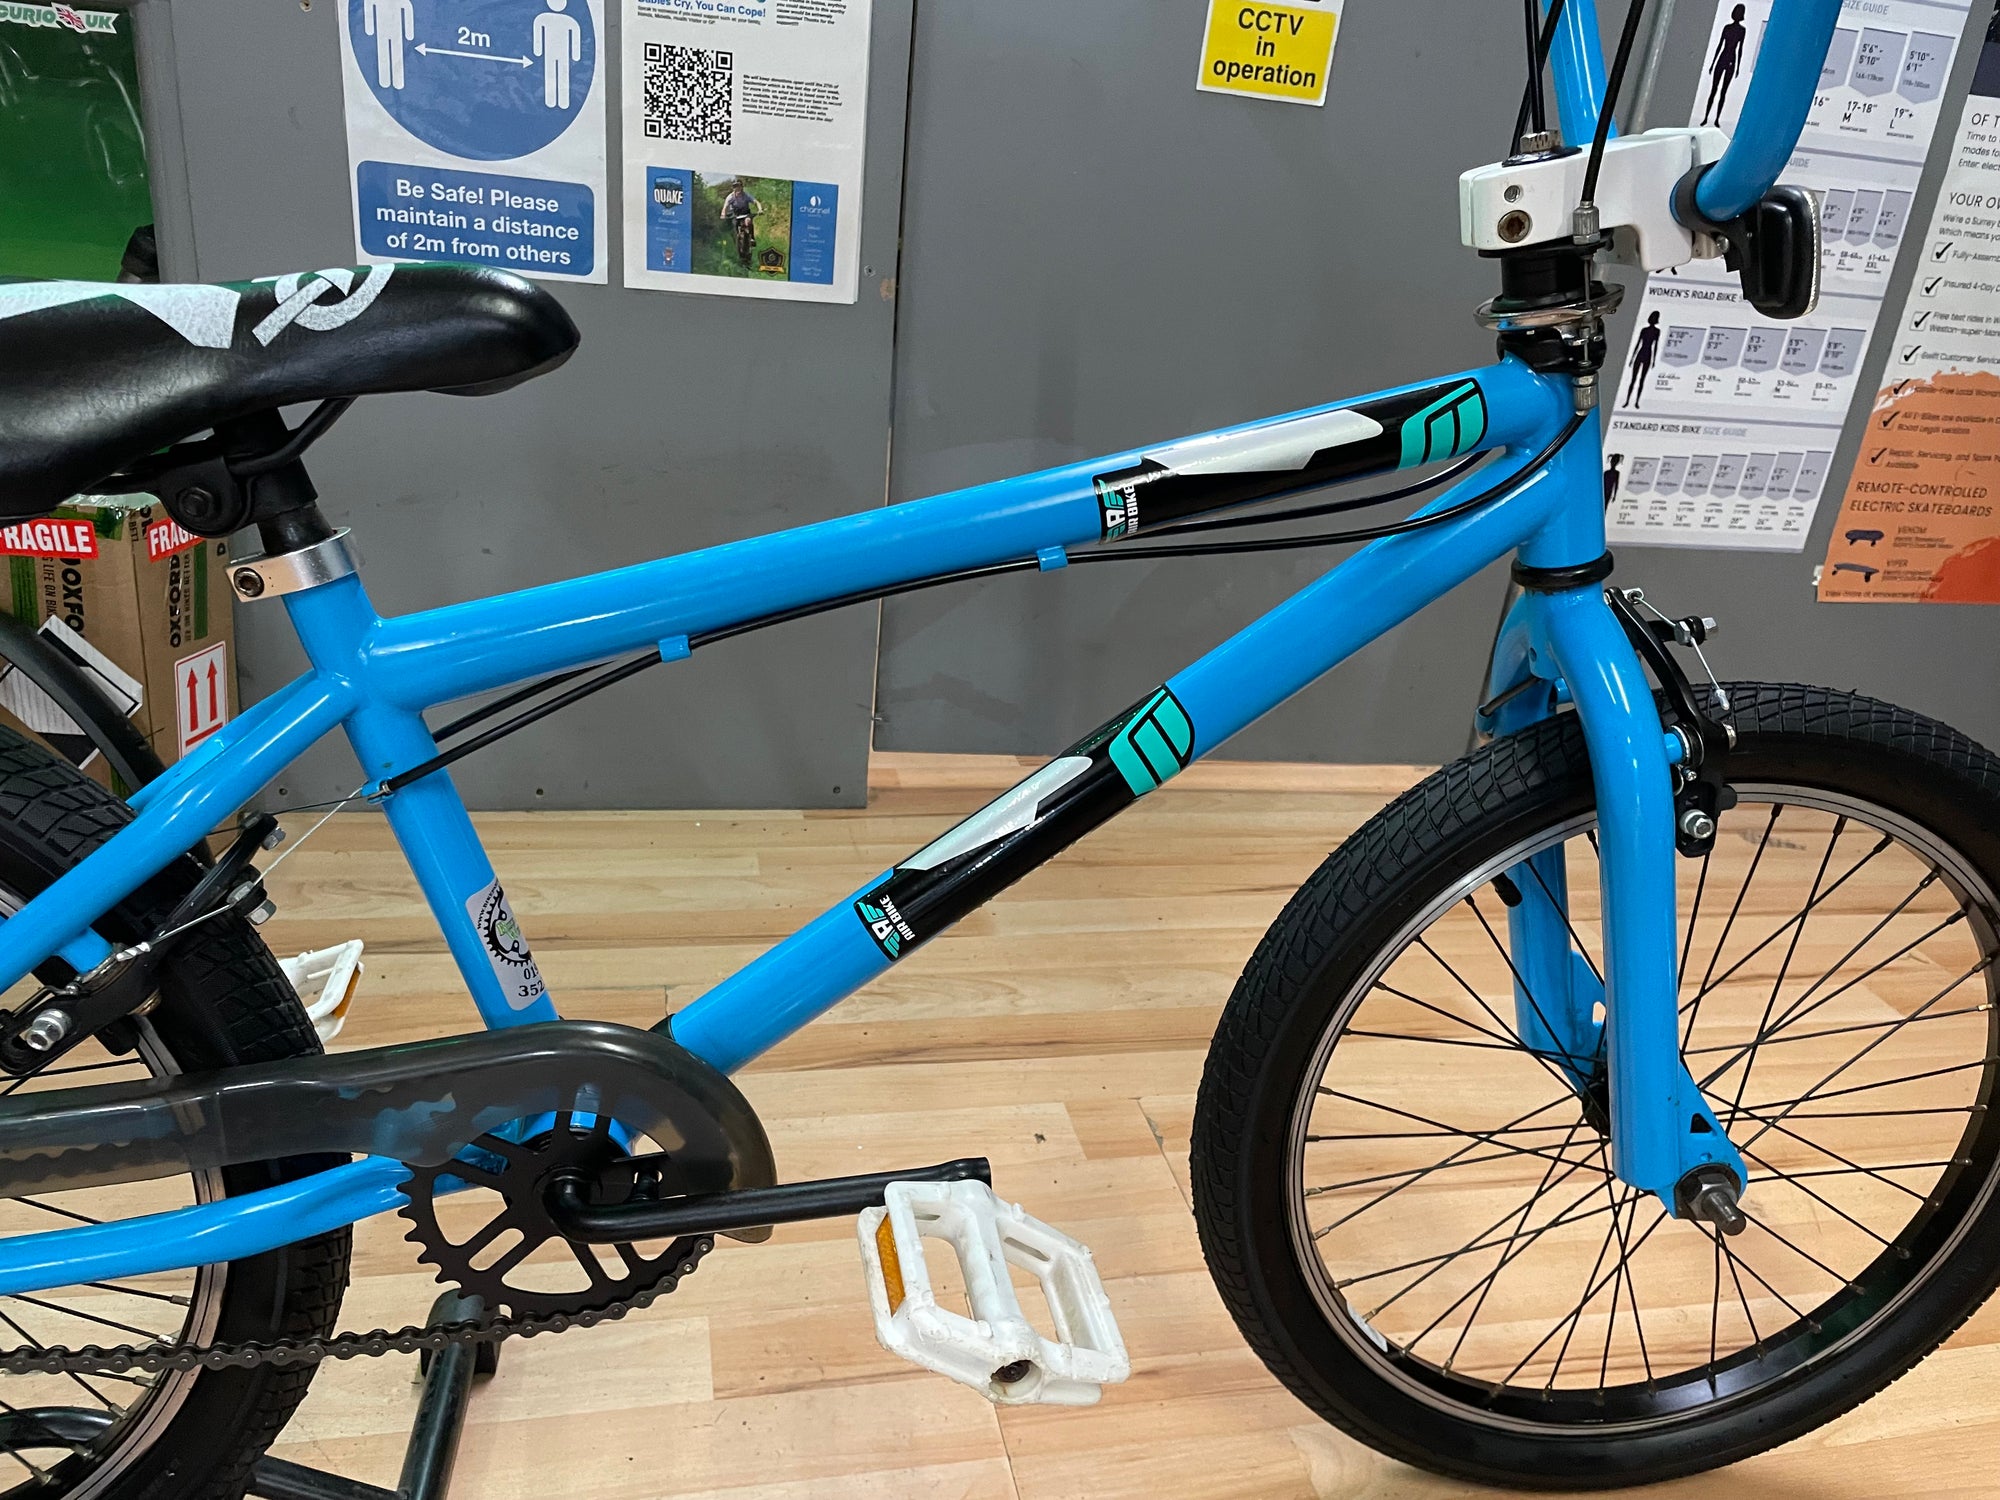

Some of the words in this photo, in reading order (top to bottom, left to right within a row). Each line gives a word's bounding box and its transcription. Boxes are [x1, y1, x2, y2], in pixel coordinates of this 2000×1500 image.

[695, 1, 714, 11] You
[716, 3, 735, 14] Can
[738, 6, 766, 18] Cope!
[1863, 2, 1889, 15] GUIDE
[86, 14, 113, 30] UK
[1238, 8, 1304, 35] CCTV
[457, 26, 491, 47] 2m
[1256, 36, 1275, 57] in
[1213, 60, 1316, 88] operation
[1842, 113, 1852, 123] M
[1889, 119, 1895, 129] L
[1971, 113, 1990, 126] OF
[1967, 131, 1986, 142] Time
[1988, 134, 1997, 143] to
[1962, 146, 1990, 156] modes
[1958, 158, 1980, 169] Enter
[396, 179, 425, 198] Be
[431, 183, 484, 204] Safe!
[490, 189, 559, 212] Please
[654, 188, 684, 205] QUAKE
[1949, 192, 1983, 207] YOUR
[376, 206, 467, 229] maintain
[473, 218, 486, 231] a
[492, 217, 579, 241] distance
[386, 233, 408, 248] of
[413, 234, 445, 252] 2m
[451, 238, 500, 258] from
[506, 246, 571, 265] others
[1649, 287, 1690, 299] WOMEN'S
[1691, 290, 1715, 301] ROAD
[1716, 292, 1738, 303] BIKE
[1612, 421, 1659, 432] STANDARD
[1660, 423, 1680, 433] KIDS
[1681, 425, 1702, 435] BIKE
[1856, 481, 1988, 499] REMOTE-CONTROLLED
[1123, 484, 1139, 517] BIKE
[1850, 499, 1905, 513] ELECTRIC
[1907, 501, 1993, 517] SKATEBOARDS
[169, 554, 181, 648] OXFORD
[879, 894, 902, 924] BIKE
[896, 921, 916, 941] AIR
